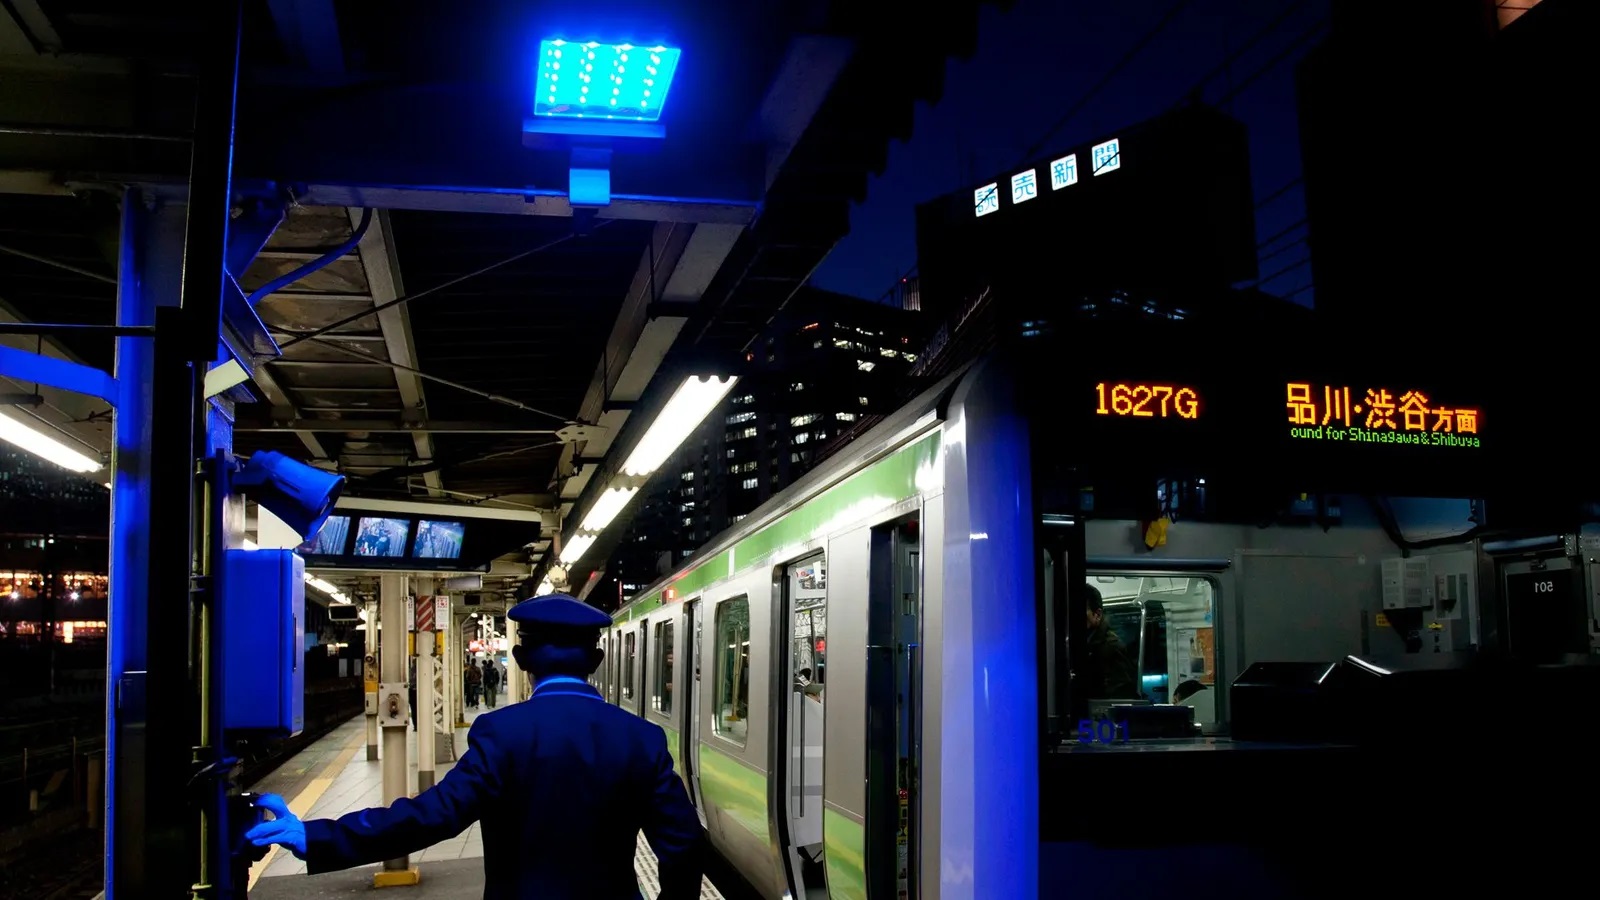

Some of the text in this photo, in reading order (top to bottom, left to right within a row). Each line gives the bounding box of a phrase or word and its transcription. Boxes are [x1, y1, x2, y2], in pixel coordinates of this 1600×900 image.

[976, 142, 1119, 213] 読売新聞
[1096, 383, 1198, 418] 1627G
[1291, 427, 1322, 439] ound
[1325, 427, 1347, 441] for
[1077, 719, 1129, 744] 501
